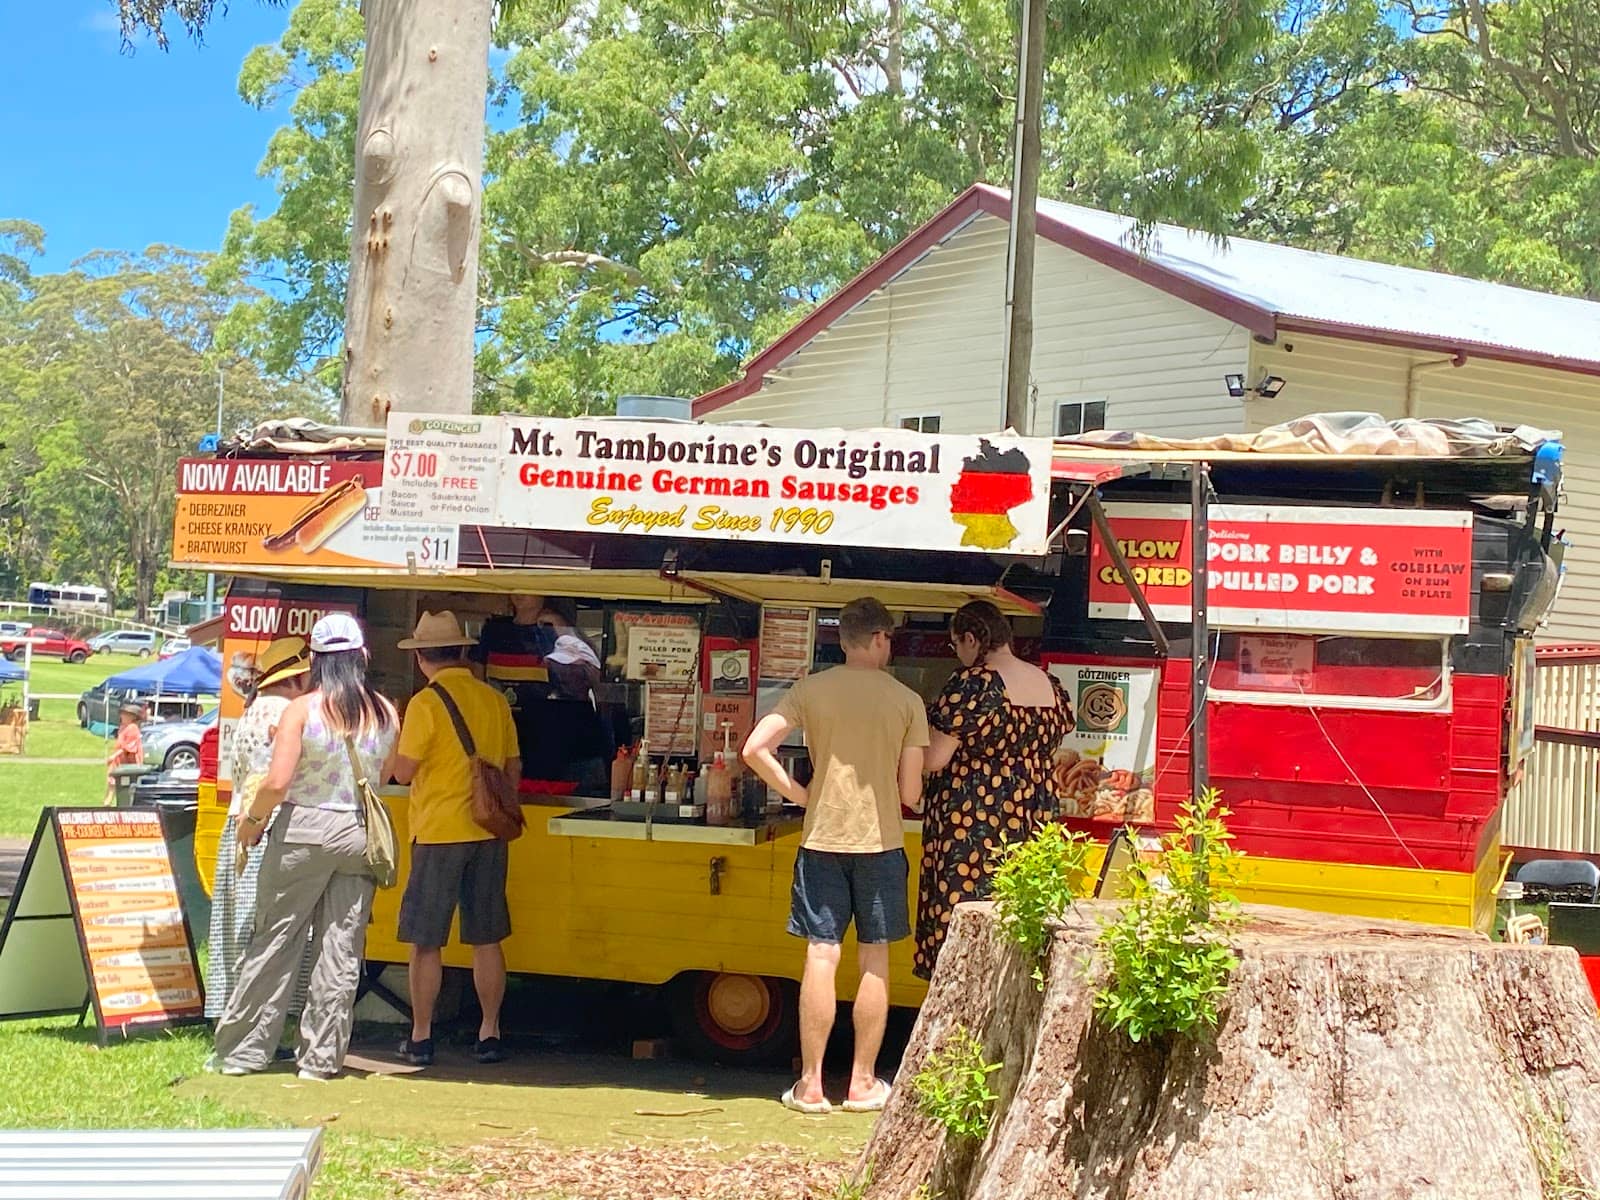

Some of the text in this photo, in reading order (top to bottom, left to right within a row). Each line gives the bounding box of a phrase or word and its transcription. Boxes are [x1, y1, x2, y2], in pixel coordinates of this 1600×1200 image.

[390, 439, 404, 447] THE
[426, 440, 457, 449] QUALITY
[459, 442, 498, 450] SAUSAGES
[509, 427, 942, 479] Mt. Tamborine's Original
[390, 452, 437, 479] $7.00
[182, 463, 331, 493] NOW AVAILABLE
[401, 477, 479, 490] Includes FREE
[518, 463, 919, 509] Genuine German Sausages
[391, 490, 476, 502] Bacon Sauerkraut
[189, 502, 246, 518] DEBREZINER
[390, 509, 423, 518] Mustard
[391, 499, 416, 508] Sauce
[441, 504, 463, 513] Fried
[464, 505, 490, 514] Onion
[586, 497, 834, 535] Enjoyed Since 1990
[187, 521, 272, 538] CHEESE KRANSKY
[187, 541, 247, 555] BRATWURST
[421, 535, 450, 562] $11
[1116, 538, 1181, 560] SLOW
[1206, 542, 1378, 567] PORK BELLY &
[1414, 549, 1443, 557] WITH
[1098, 565, 1193, 587] COOKED
[1390, 562, 1466, 575] COLESLAW
[1207, 571, 1376, 596] PULLED PORK
[1405, 577, 1450, 586] ON BUN
[1401, 589, 1452, 599] OR PLATE
[230, 604, 325, 636] SLOW COO
[639, 645, 667, 653] PULLED
[1077, 668, 1130, 681] GÖTZINGER
[714, 703, 740, 713] CASH
